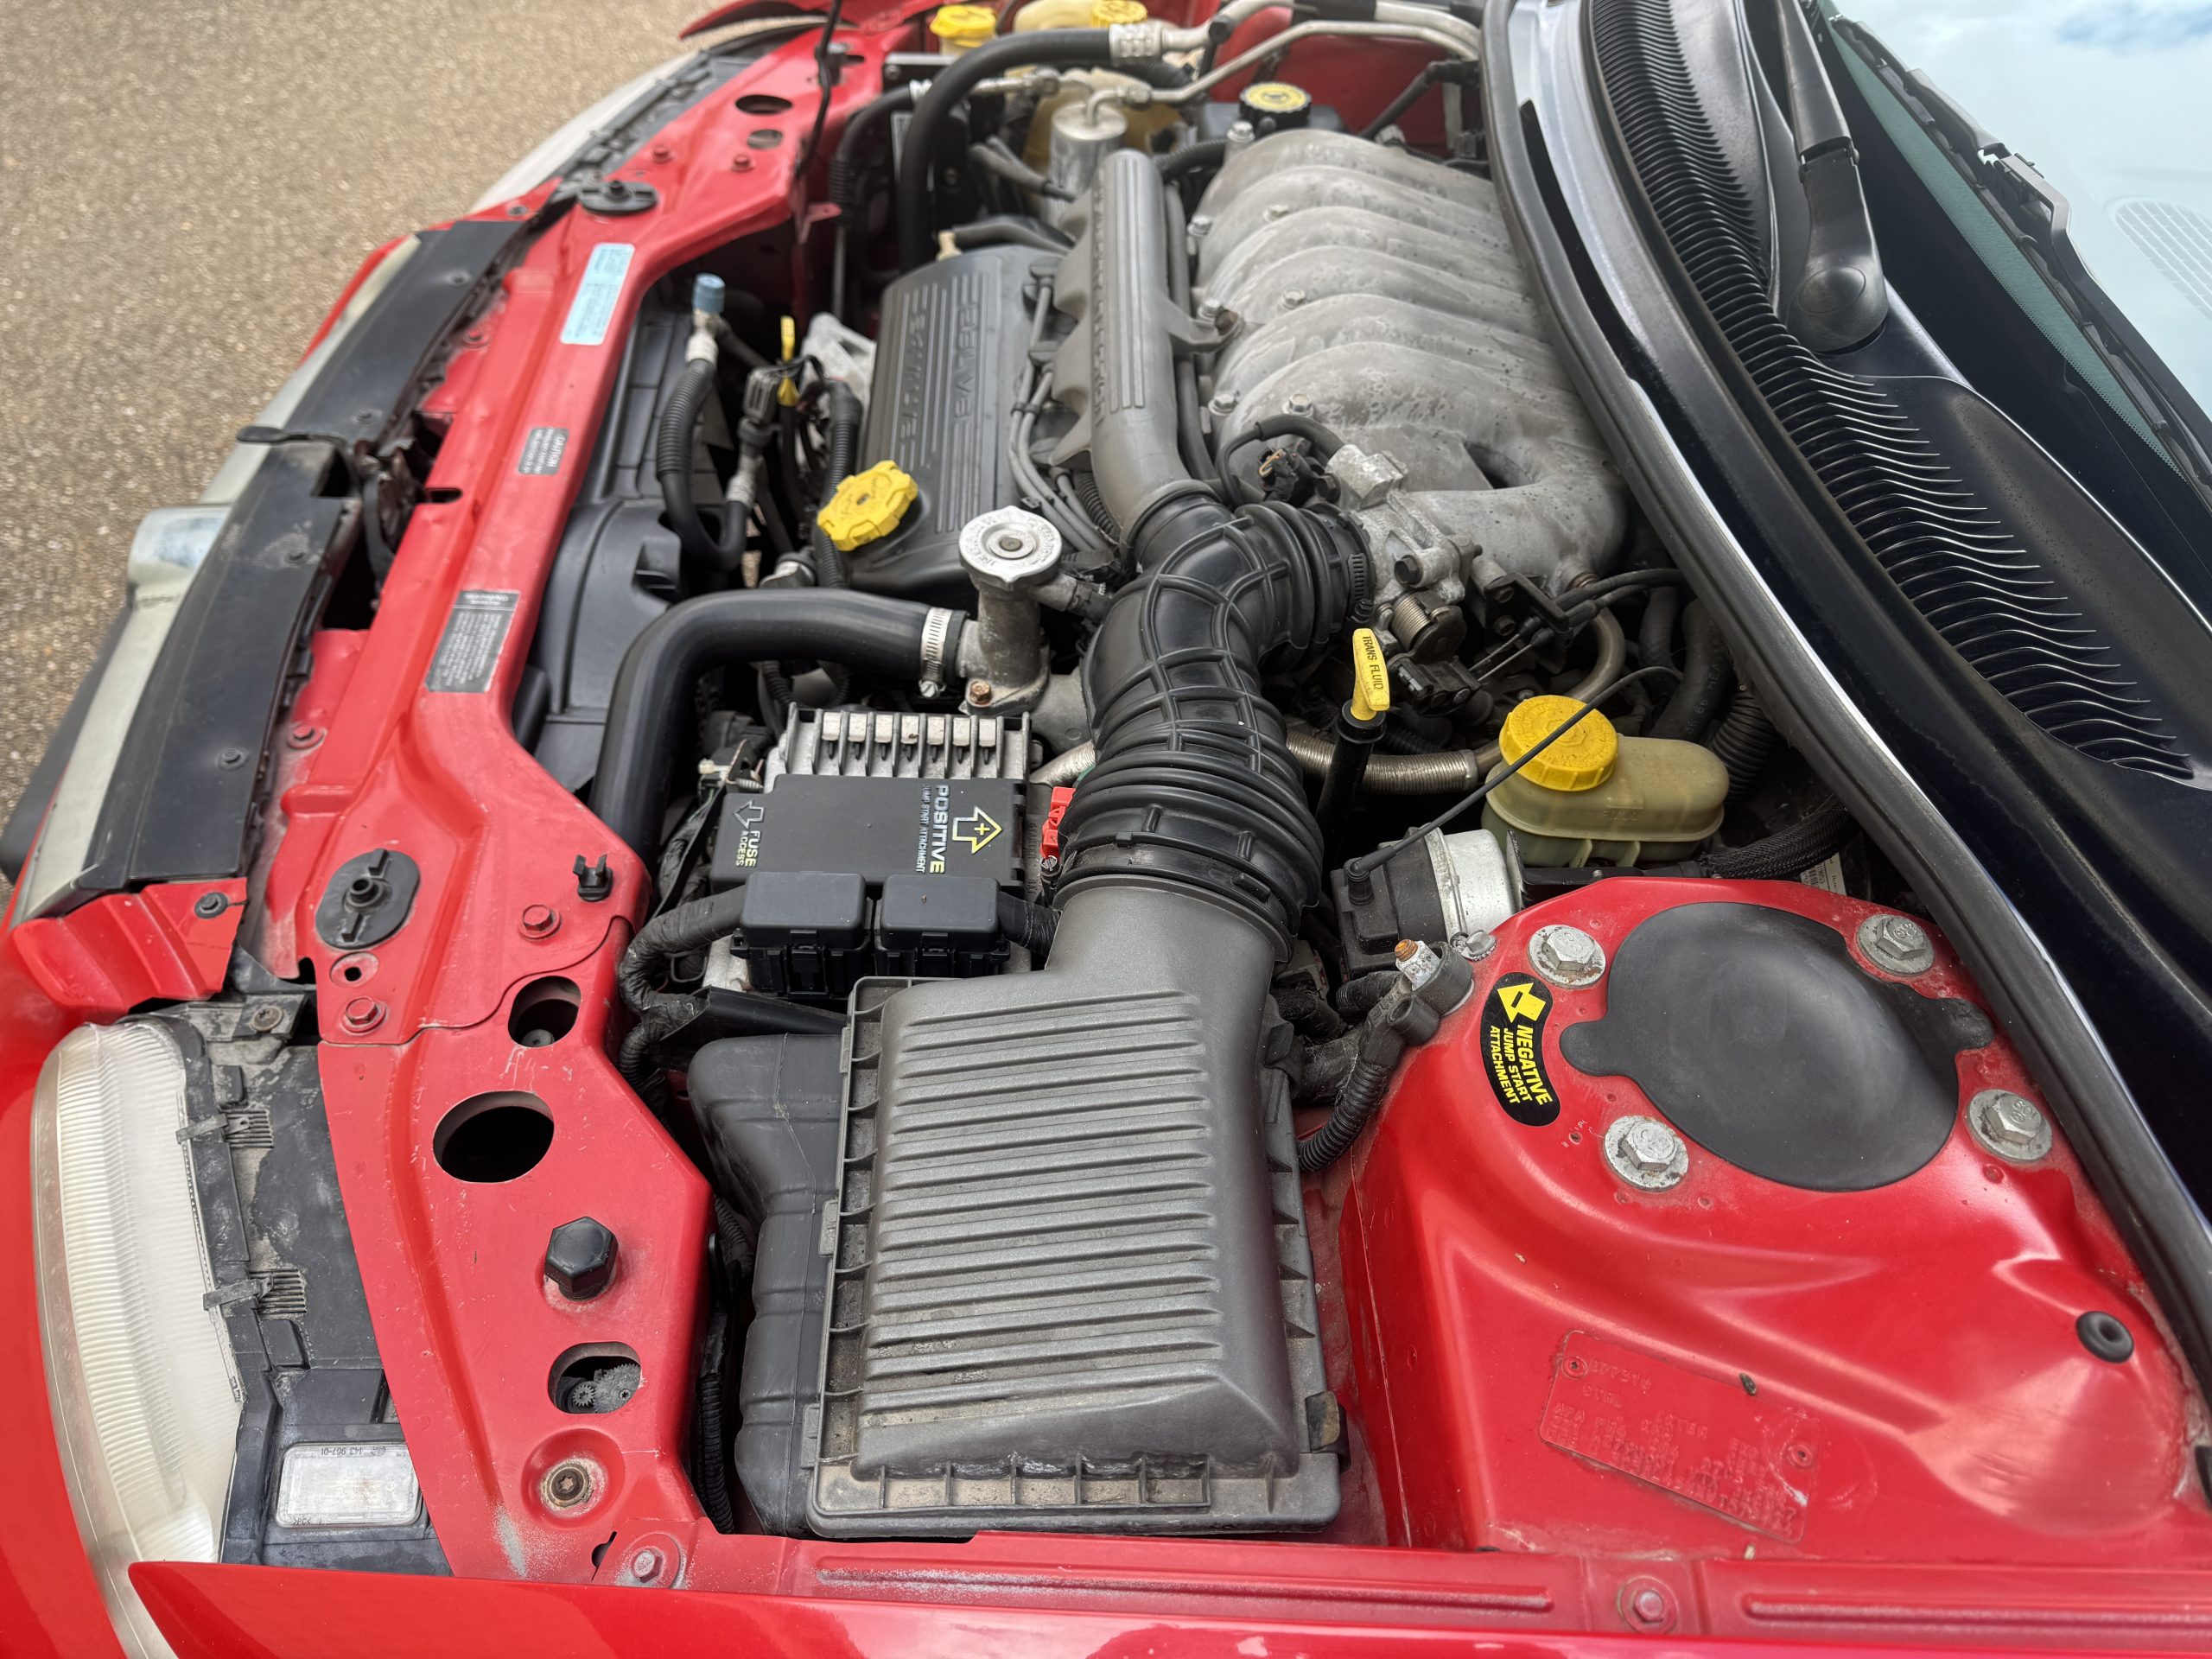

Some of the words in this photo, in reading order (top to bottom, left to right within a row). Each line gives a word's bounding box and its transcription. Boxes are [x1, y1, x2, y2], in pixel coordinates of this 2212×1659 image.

[1363, 635, 1377, 660] TRANS
[1370, 664, 1383, 690] FLUID
[921, 785, 931, 805] JUMP
[918, 804, 931, 828] START
[929, 784, 950, 874] POSITIVE
[736, 830, 748, 867] ACCESS
[745, 830, 760, 867] FUSE
[916, 826, 929, 874] ATTACHMENT
[1503, 1027, 1516, 1062] JUMP
[1491, 1025, 1521, 1103] ATTACHMENT
[1516, 1025, 1553, 1105] NEGATIVE
[1509, 1065, 1533, 1101] START
[349, 1446, 362, 1456] 143
